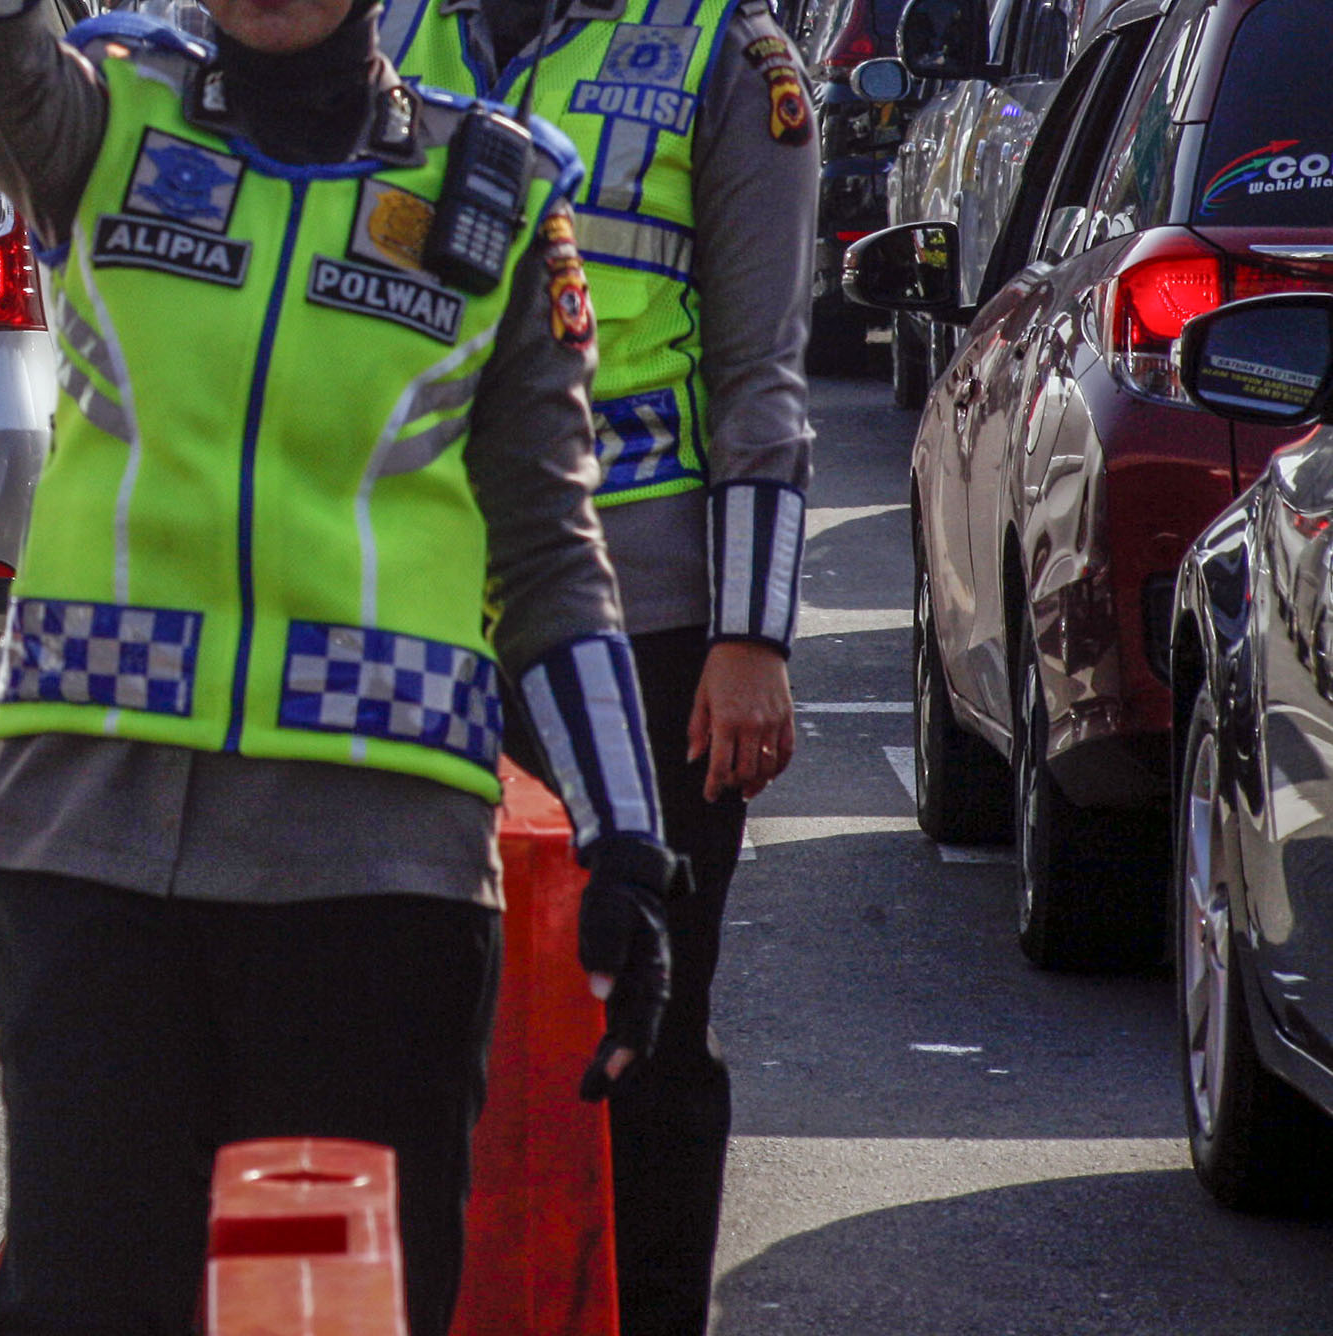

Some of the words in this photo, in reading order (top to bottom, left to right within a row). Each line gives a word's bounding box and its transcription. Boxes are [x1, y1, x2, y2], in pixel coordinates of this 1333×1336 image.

[574, 85, 695, 131] POLISI
[1248, 177, 1305, 195] Wahid
[106, 221, 232, 273] ALIPIA
[316, 266, 461, 334] POLWAN
